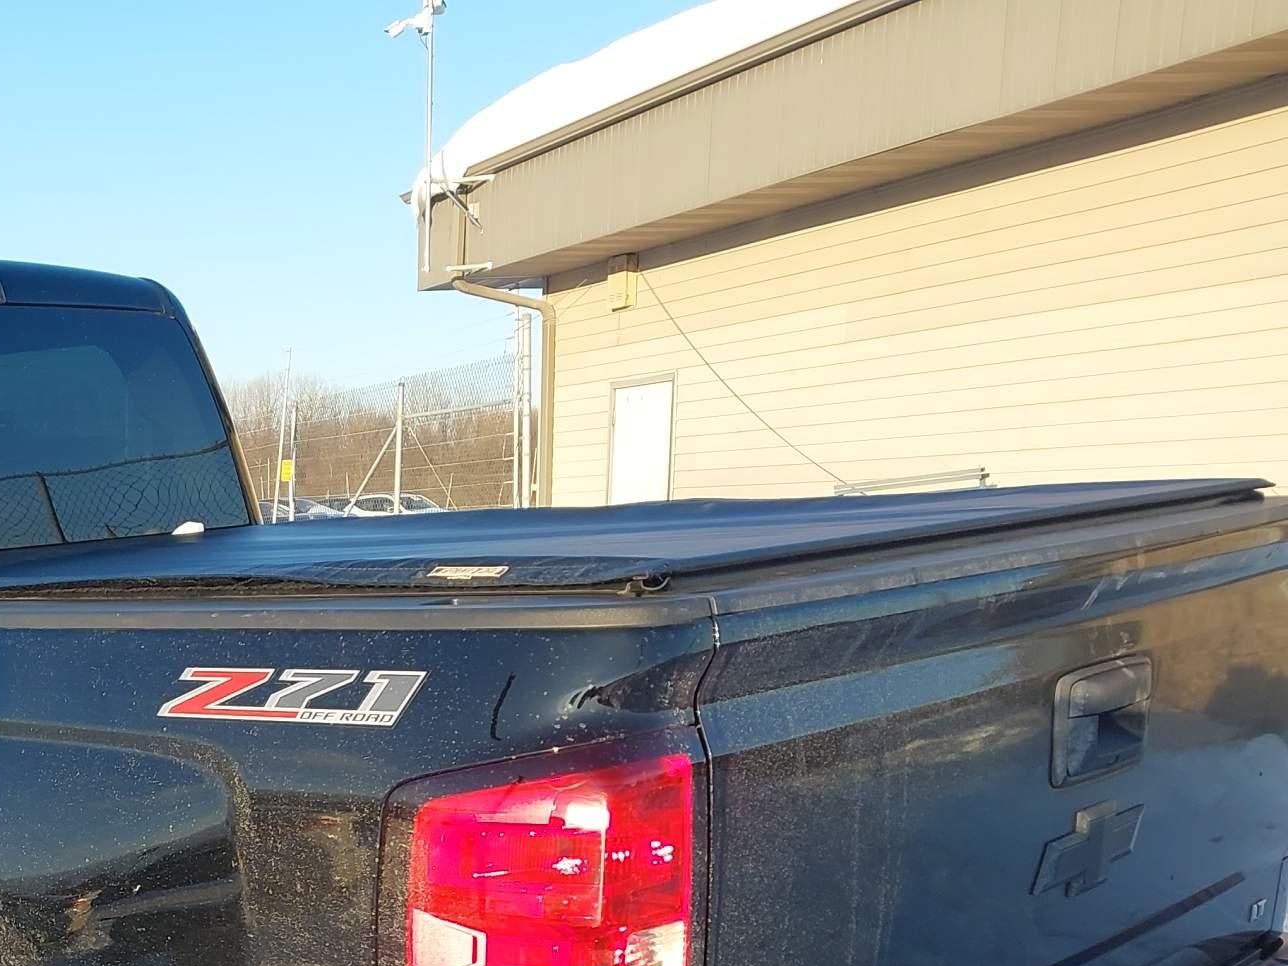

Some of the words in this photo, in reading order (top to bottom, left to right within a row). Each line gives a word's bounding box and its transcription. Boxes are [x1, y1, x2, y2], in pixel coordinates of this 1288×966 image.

[158, 667, 428, 717] Z71
[300, 710, 337, 721] OFF
[340, 711, 394, 724] ROAD
